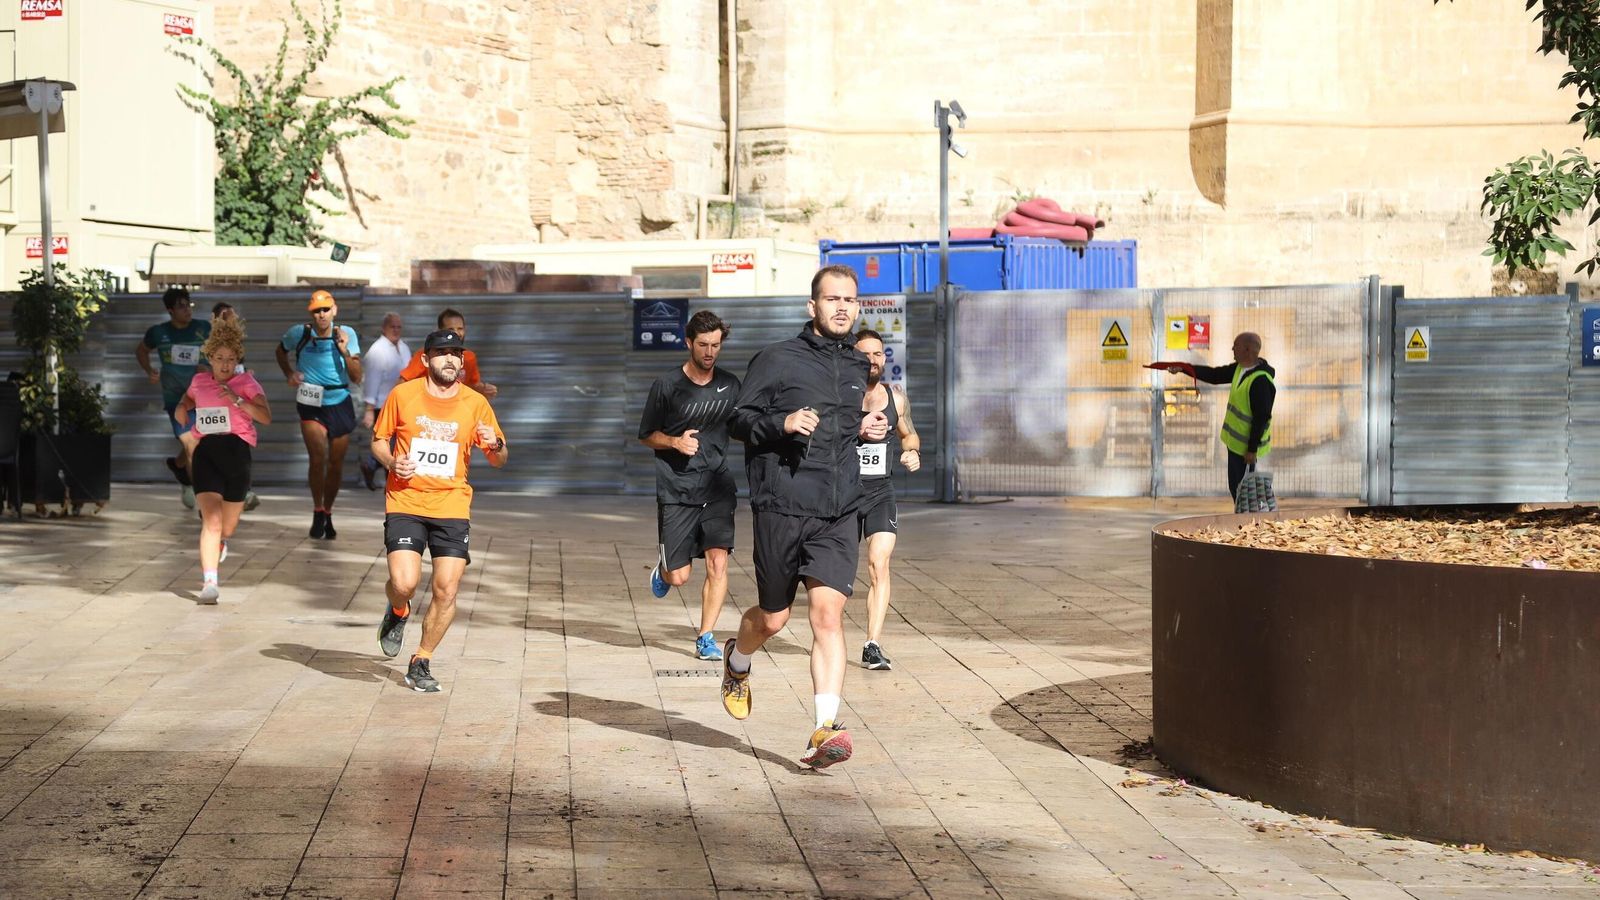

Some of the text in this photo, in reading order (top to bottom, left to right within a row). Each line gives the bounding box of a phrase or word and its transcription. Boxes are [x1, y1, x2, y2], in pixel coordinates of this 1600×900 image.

[20, 0, 63, 11] REMSA
[164, 13, 193, 29] REMSA
[712, 254, 754, 265] REMSA
[876, 307, 903, 315] OBRAS
[178, 352, 191, 360] 42
[200, 415, 227, 425] 1068
[417, 451, 448, 465] 700
